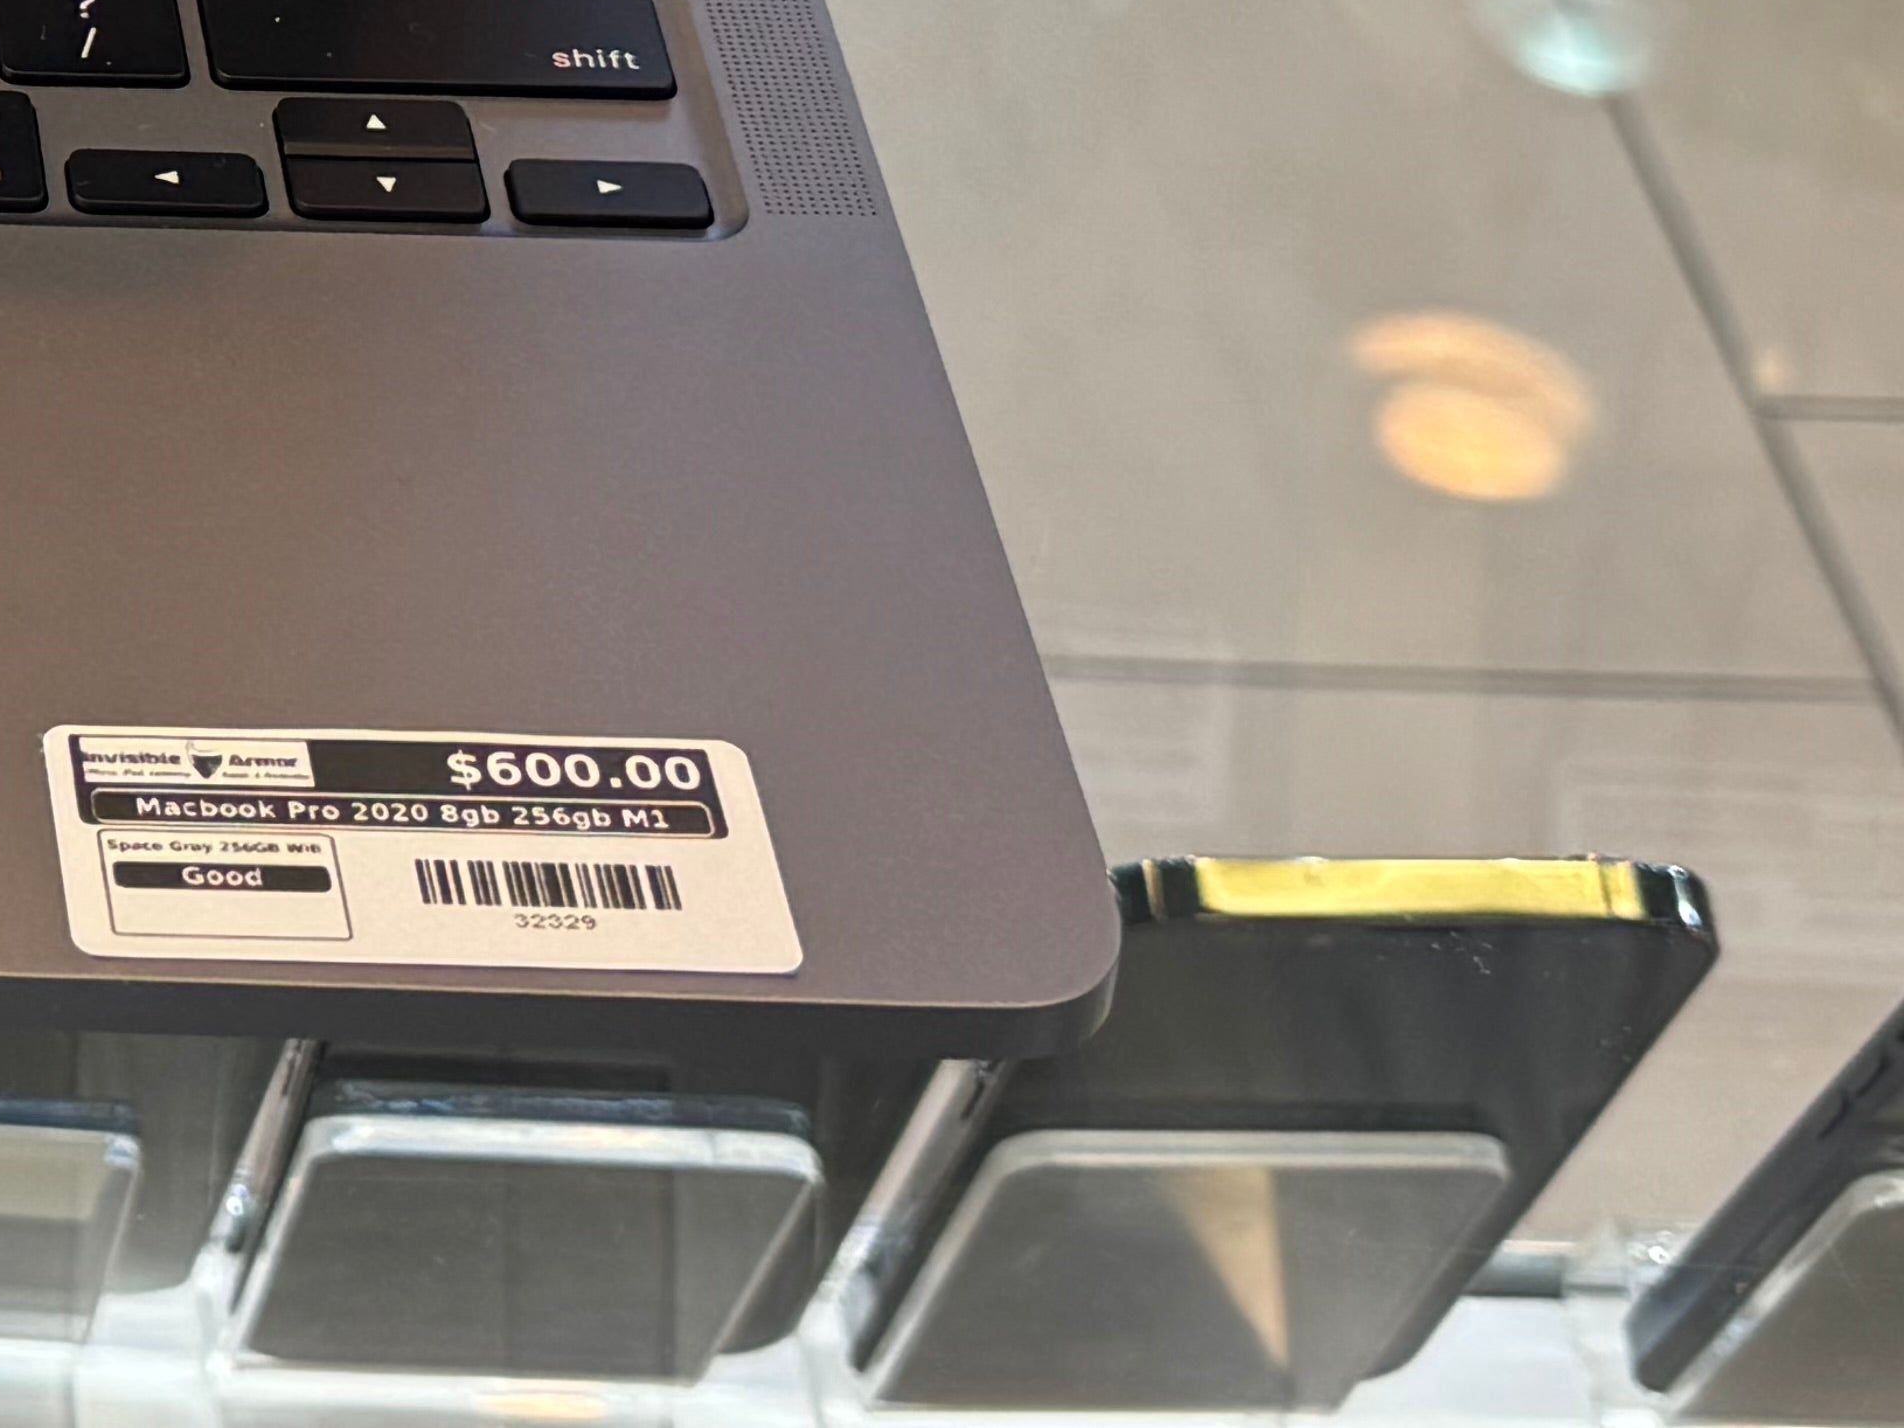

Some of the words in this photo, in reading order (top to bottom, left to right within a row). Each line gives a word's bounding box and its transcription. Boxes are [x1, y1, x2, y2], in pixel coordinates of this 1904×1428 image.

[552, 48, 640, 70] shift
[445, 749, 701, 790] $600.00
[136, 797, 276, 818] Macbook
[287, 800, 340, 821] Pro
[351, 802, 429, 822] 2020
[440, 803, 500, 828] 8gb
[511, 805, 612, 831] 256gb
[621, 808, 669, 829] M1
[106, 839, 163, 852] Space
[169, 840, 212, 853] Gray
[181, 866, 262, 885] Good
[514, 912, 596, 931] 32329
